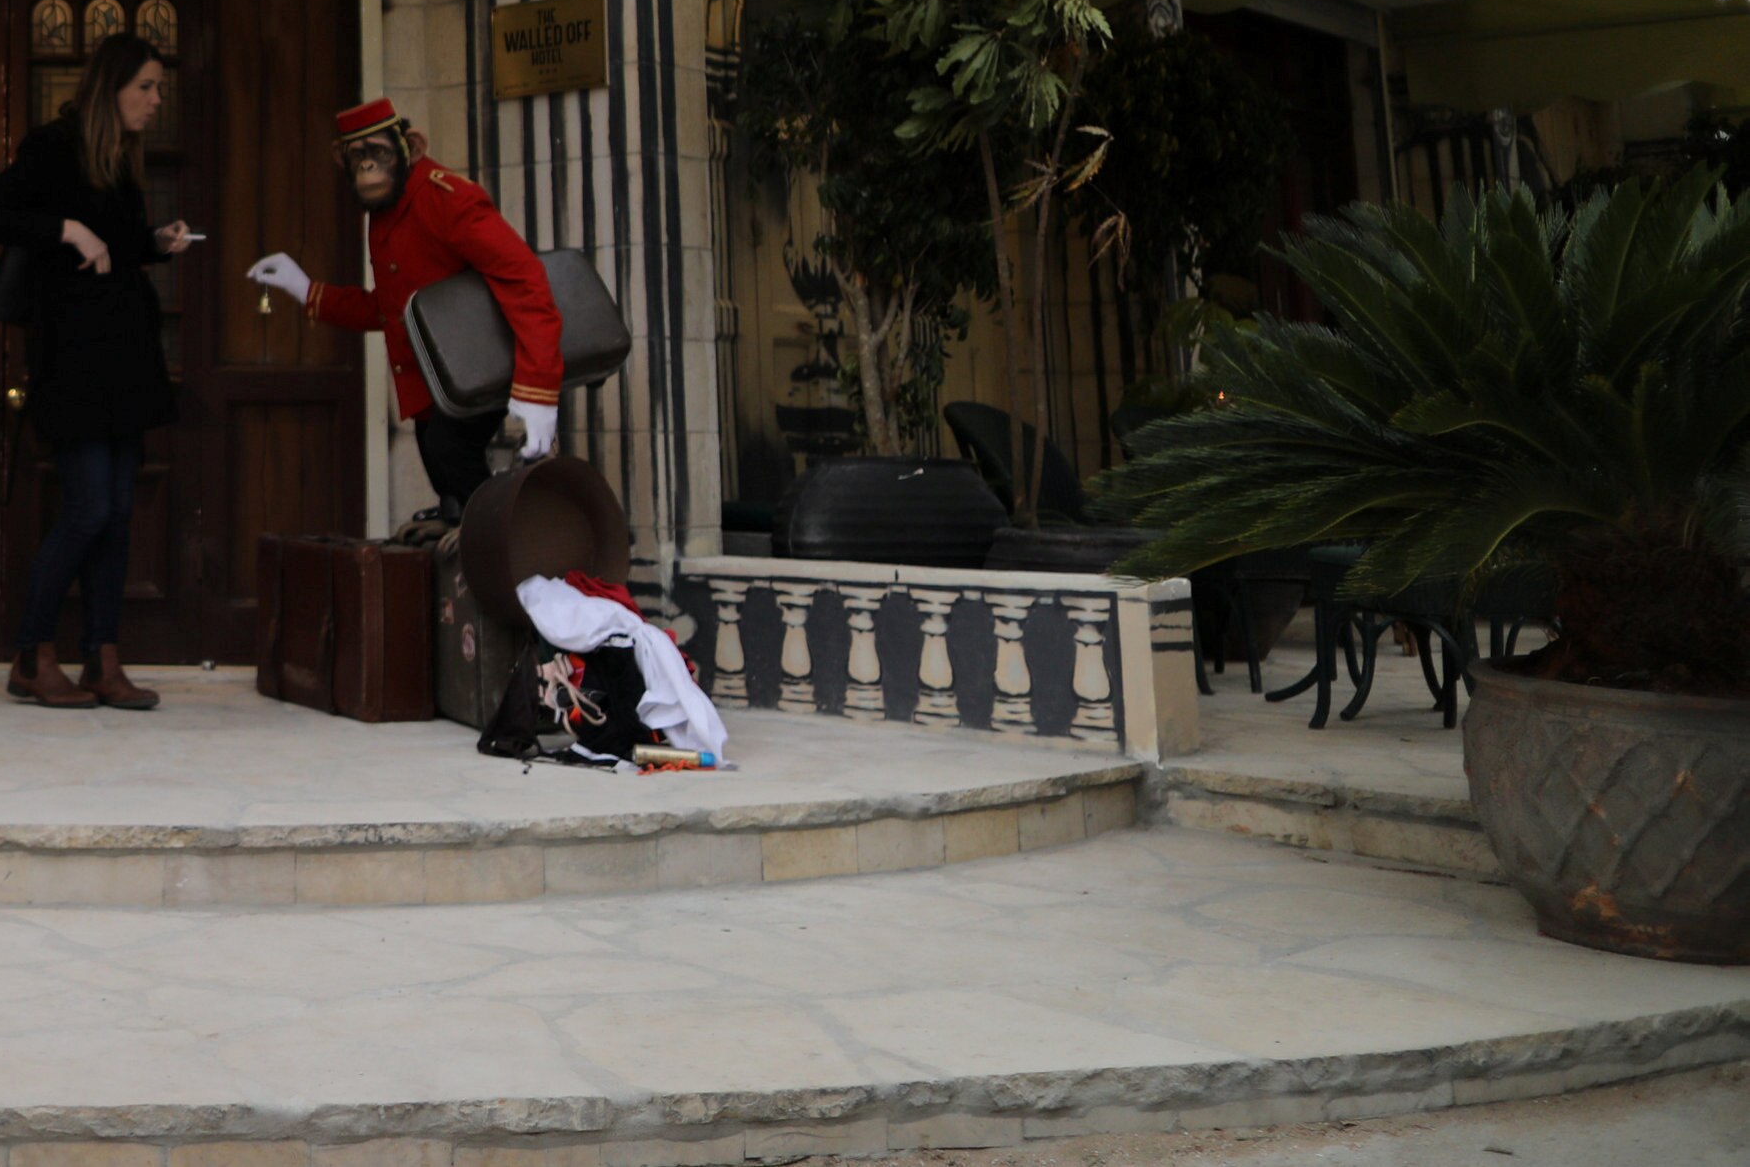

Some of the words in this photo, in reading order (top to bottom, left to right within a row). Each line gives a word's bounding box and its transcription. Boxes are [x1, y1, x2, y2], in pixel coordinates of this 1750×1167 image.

[537, 8, 556, 25] THE
[504, 24, 563, 52] WALLED
[566, 20, 591, 44] OFF
[531, 48, 562, 65] HOTEL
